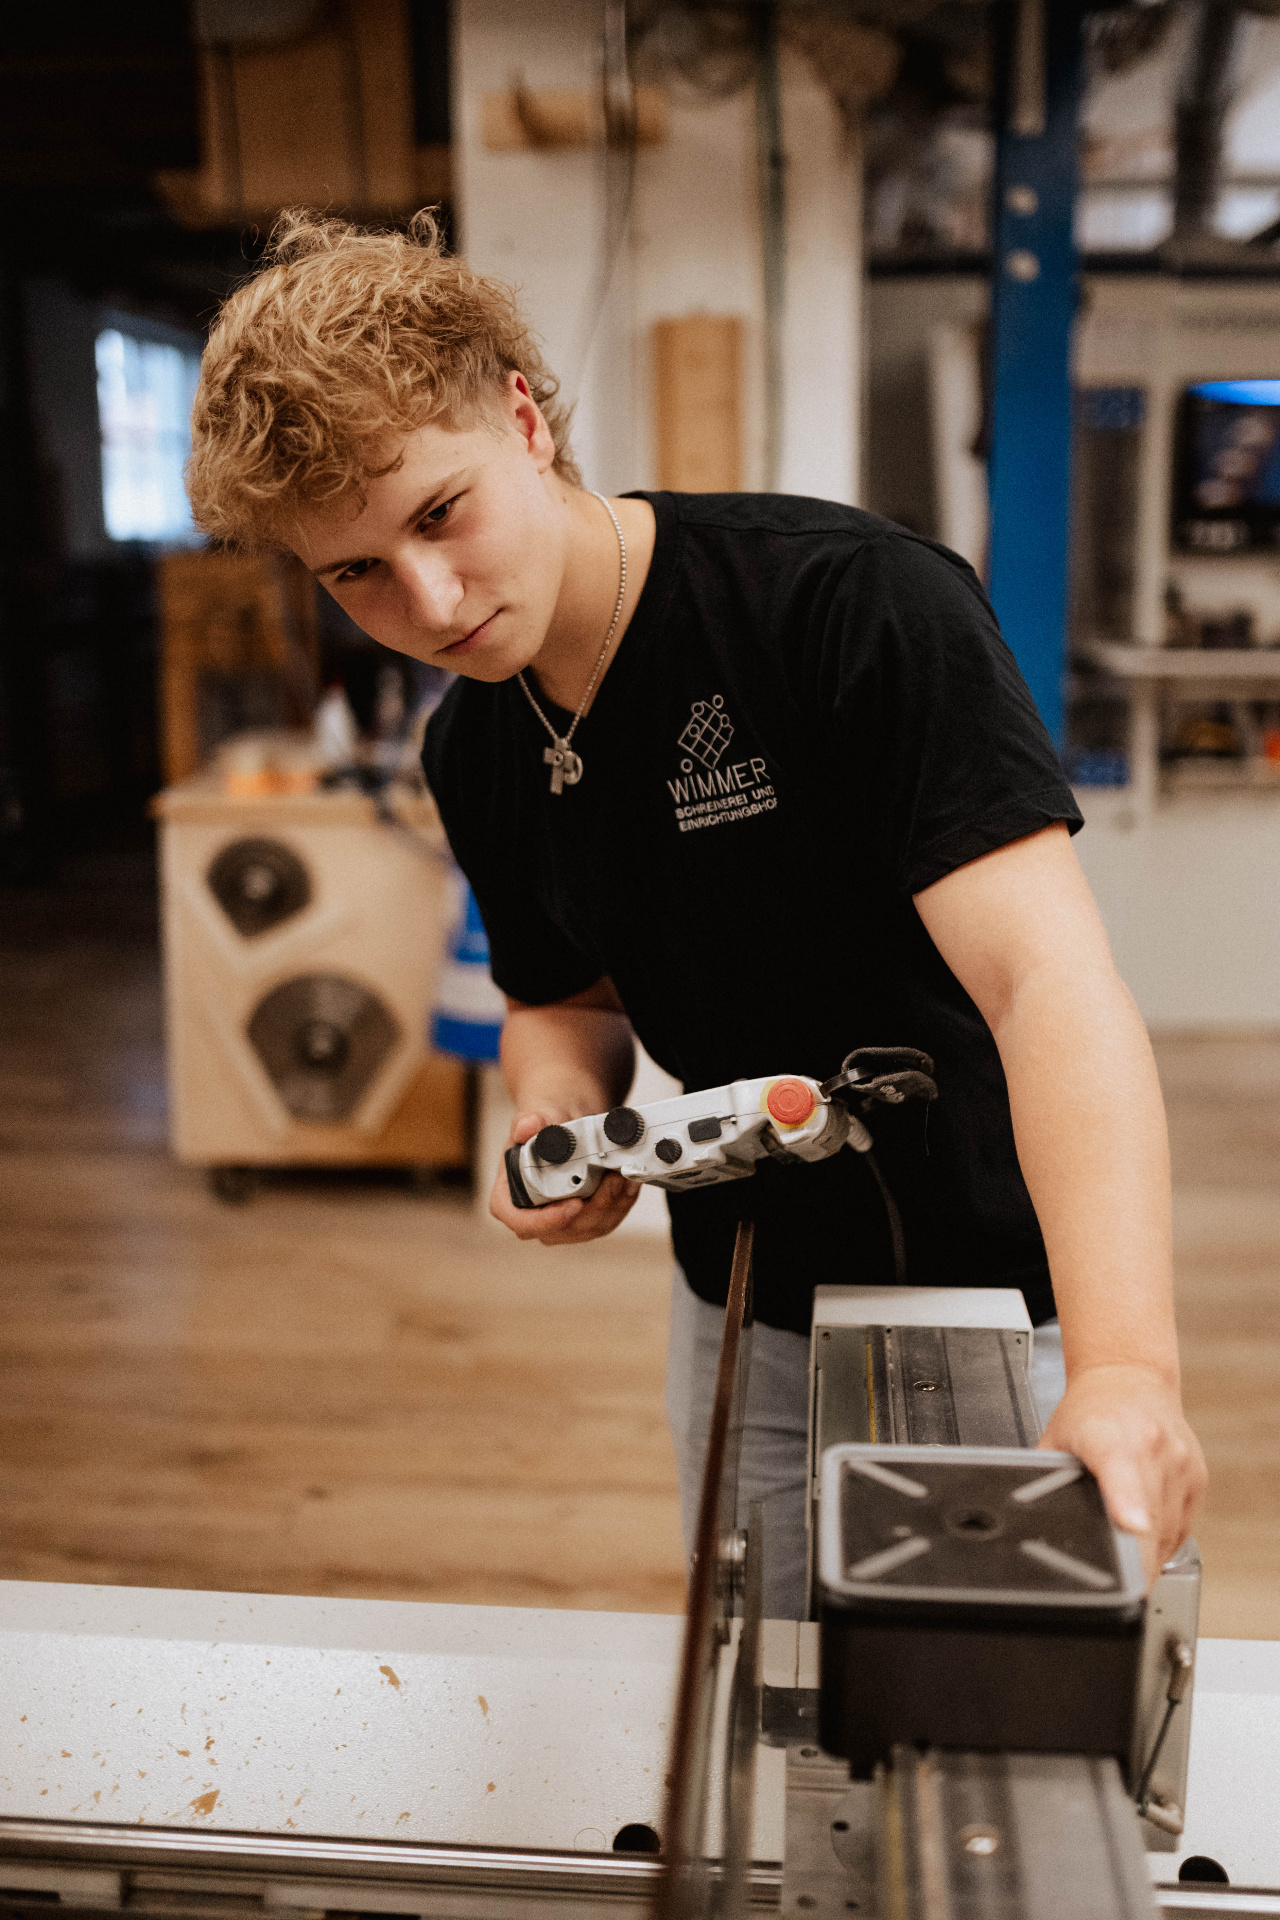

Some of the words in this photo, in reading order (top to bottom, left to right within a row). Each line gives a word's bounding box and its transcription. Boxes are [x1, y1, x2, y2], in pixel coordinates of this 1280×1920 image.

[666, 757, 771, 804] WIMMER
[675, 793, 748, 820] SCHREINEREI
[751, 785, 775, 800] UND
